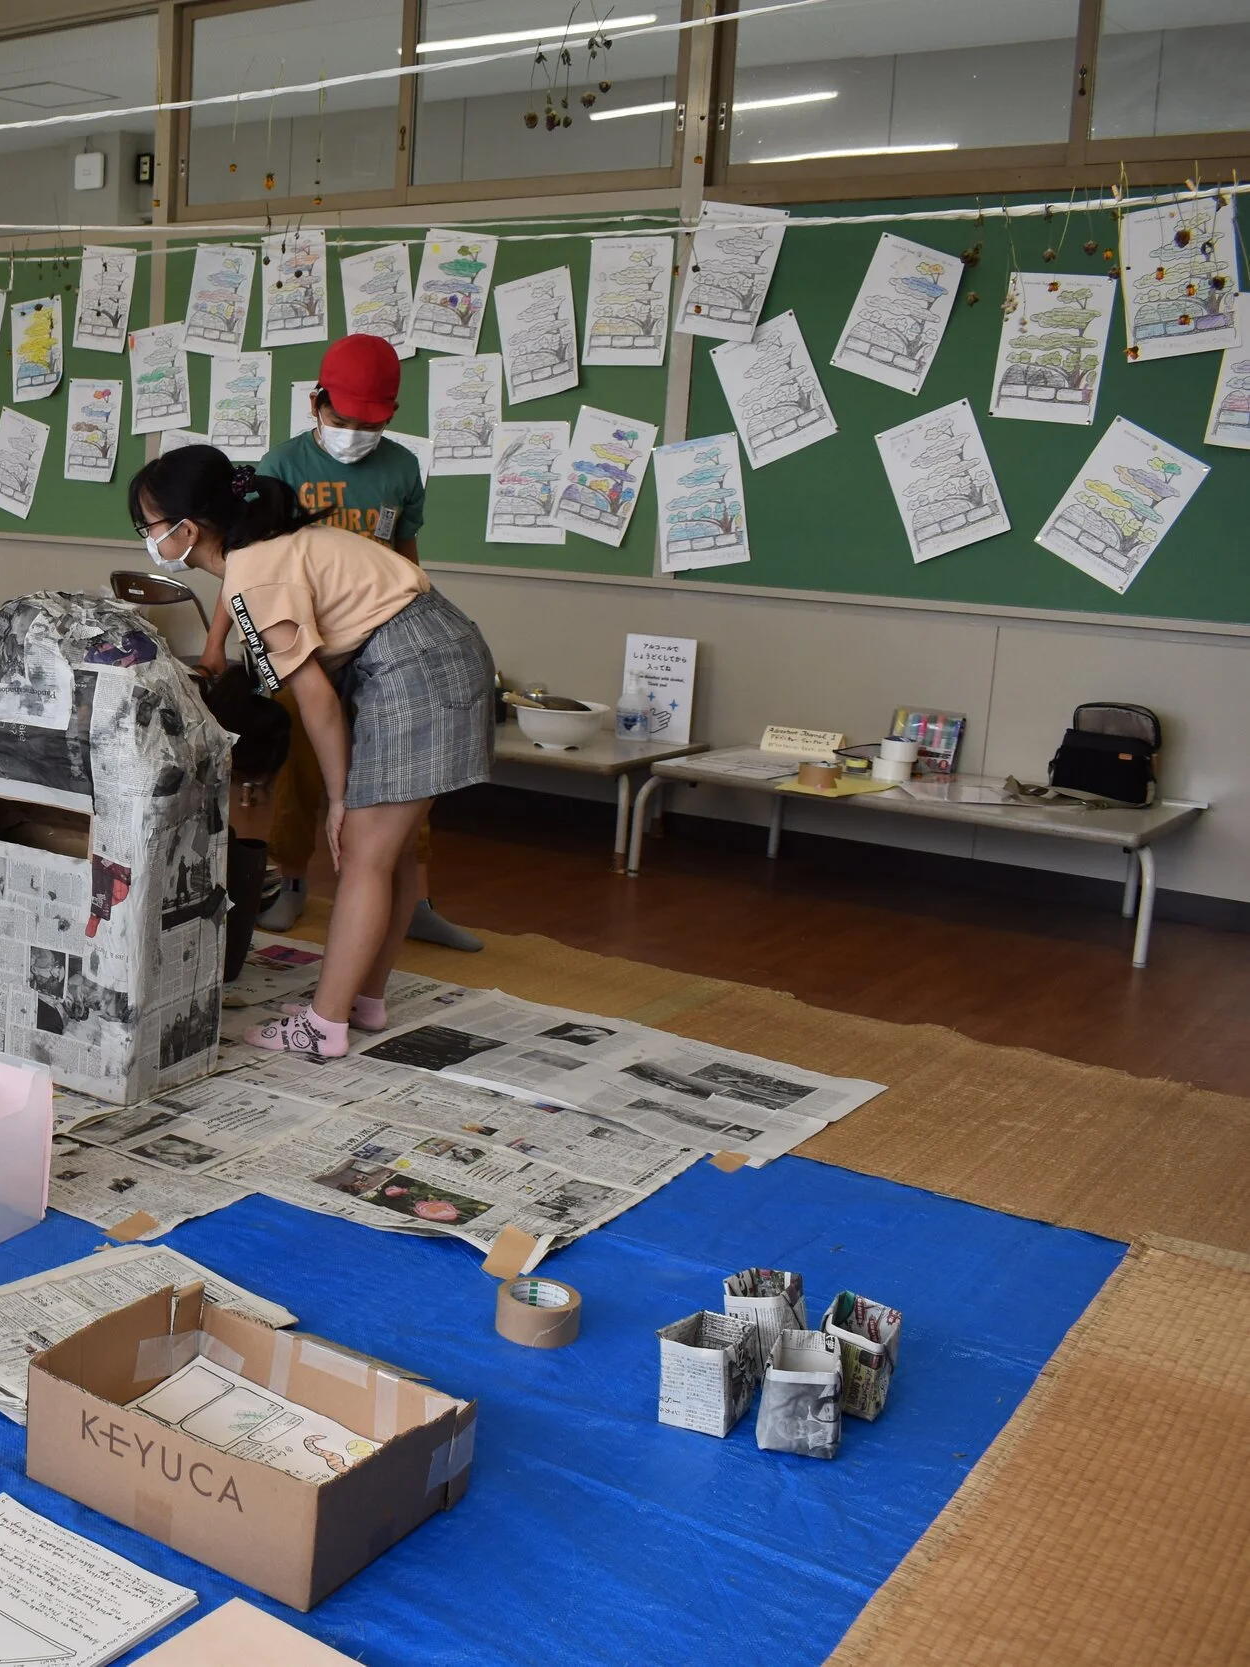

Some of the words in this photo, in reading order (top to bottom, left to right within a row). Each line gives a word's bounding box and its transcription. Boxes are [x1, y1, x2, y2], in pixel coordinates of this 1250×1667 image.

[299, 481, 347, 508] GET
[232, 596, 245, 612] DAY
[238, 612, 255, 634] LUCKY
[247, 632, 260, 648] DAY
[643, 642, 679, 652] アルコールで
[633, 652, 687, 663] しょうどくしてから
[257, 655, 273, 677] LUCKY
[267, 675, 280, 691] DAY
[647, 663, 671, 671] 入ってね
[80, 1409, 244, 1513] KEYUCA
